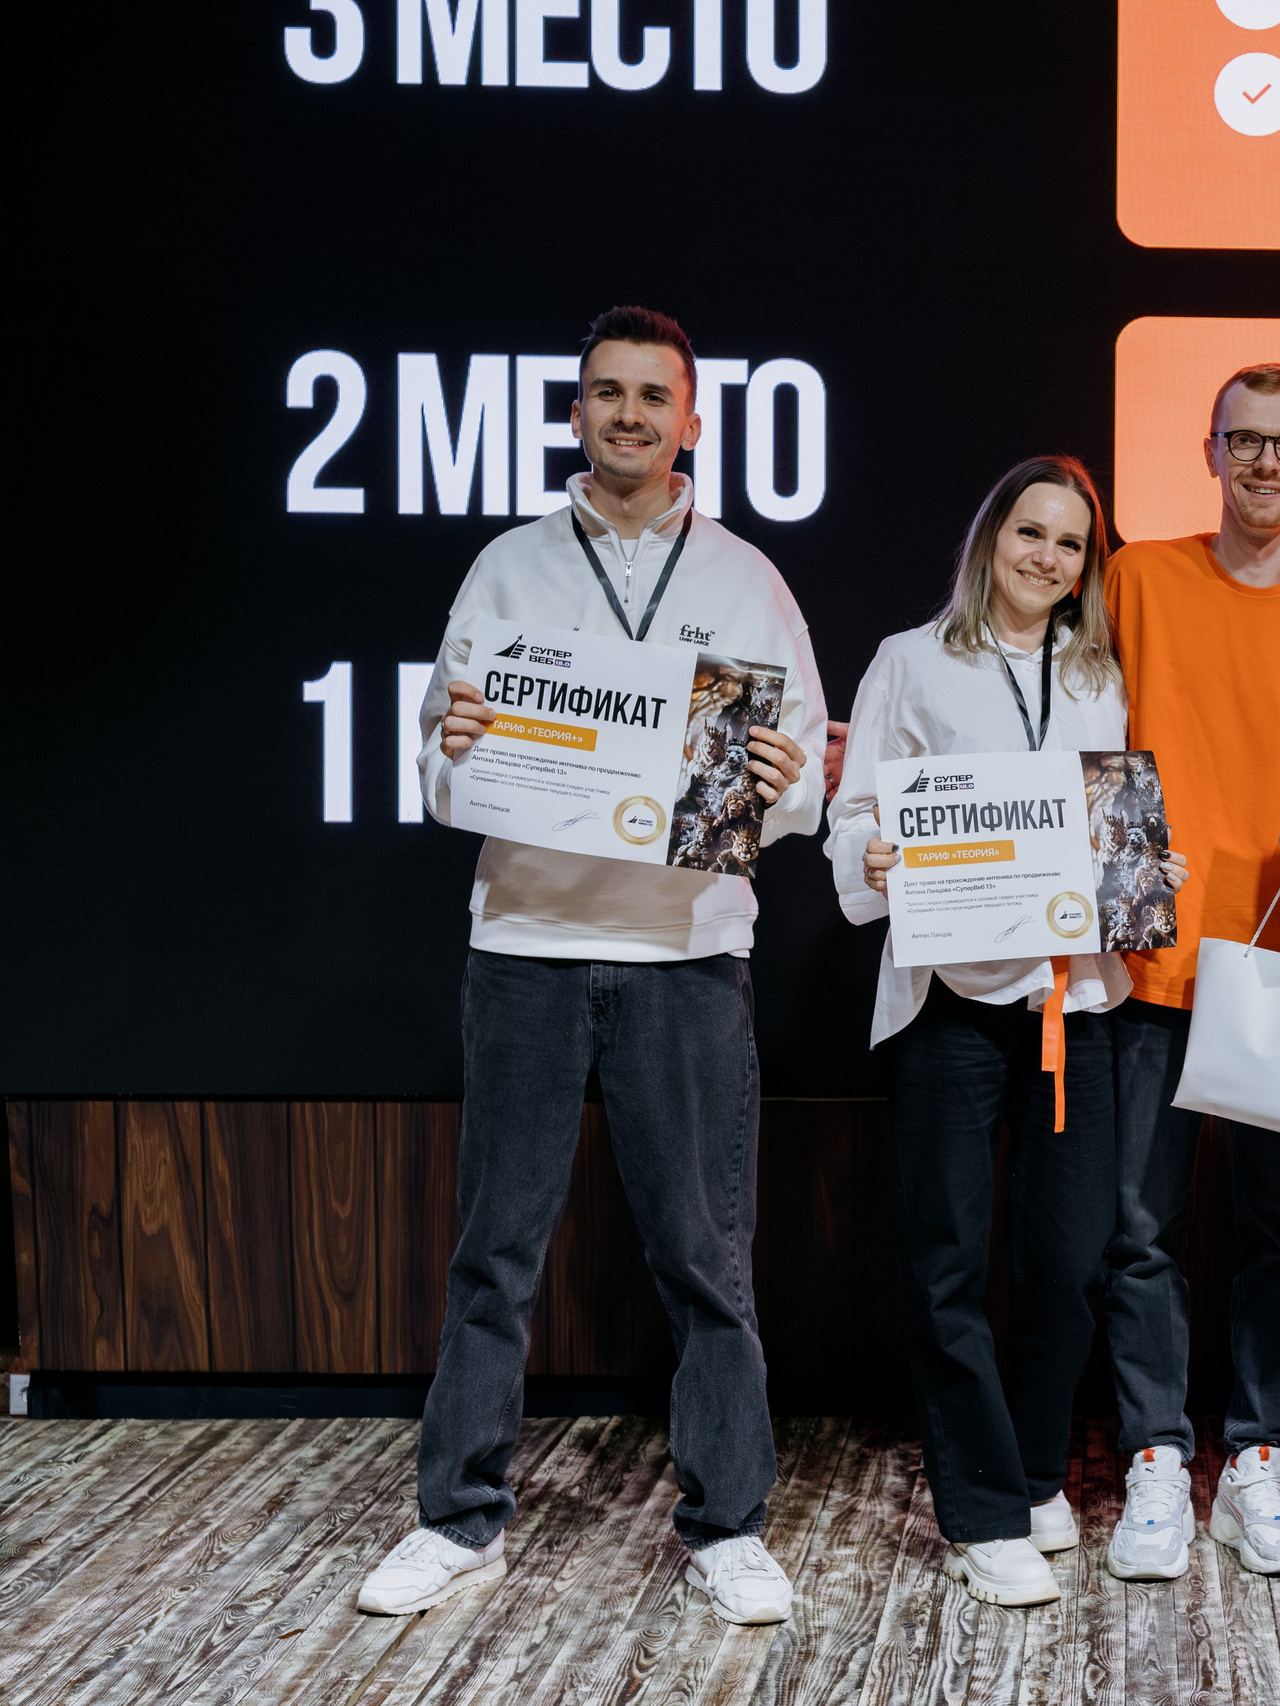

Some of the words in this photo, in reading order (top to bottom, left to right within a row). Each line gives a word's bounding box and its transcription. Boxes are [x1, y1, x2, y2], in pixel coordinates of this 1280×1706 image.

[283, 0, 365, 85] 3
[397, 0, 828, 94] МЕСТО
[285, 350, 365, 513] 2
[398, 353, 828, 522] МЕТО
[528, 656, 554, 666] ВЕБ
[530, 646, 572, 659] СУПЕР
[484, 670, 667, 729] СЕРТИФИКАТ
[493, 721, 525, 733] ТАРИФ
[528, 727, 583, 743] «ТЕОРИЯ+»
[301, 661, 353, 824] 1
[472, 754, 494, 764] Антона
[495, 758, 521, 768] Ланцова
[522, 763, 555, 773] «СуперВеб
[474, 745, 489, 754] Дает
[518, 754, 558, 765] прохождение
[597, 767, 641, 778] продвижению
[934, 774, 973, 783] СУПЕР
[935, 784, 958, 792] ВЕБ
[470, 799, 487, 808] Антон
[488, 802, 510, 812] Ланцов
[899, 799, 1066, 838] СЕРТИФИКАТ
[917, 850, 950, 862] ТАРИФ
[952, 848, 999, 860] «ТЕОРИЯ»
